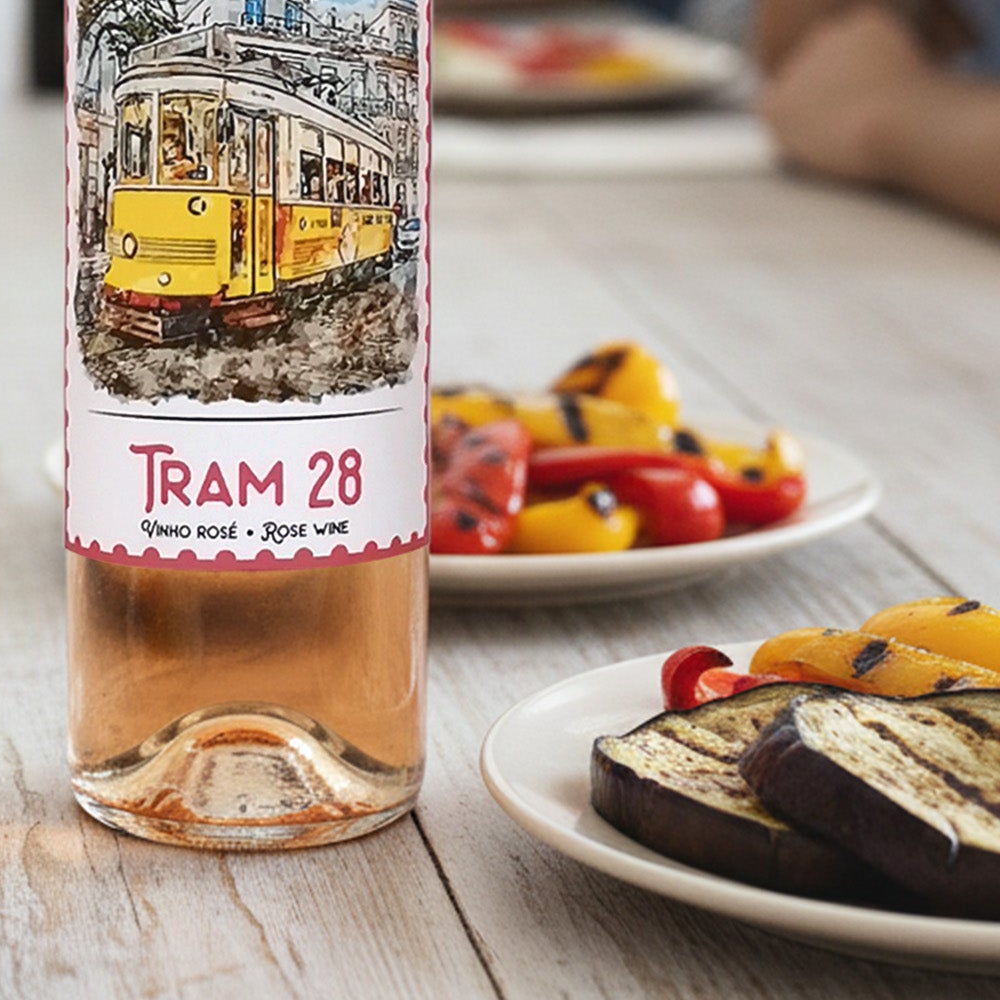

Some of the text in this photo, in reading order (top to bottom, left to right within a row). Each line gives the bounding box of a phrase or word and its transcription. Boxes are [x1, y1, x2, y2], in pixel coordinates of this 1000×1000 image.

[129, 443, 363, 514] TRAM 28
[140, 518, 350, 545] VINHO ROSÉ ROSE WINE
